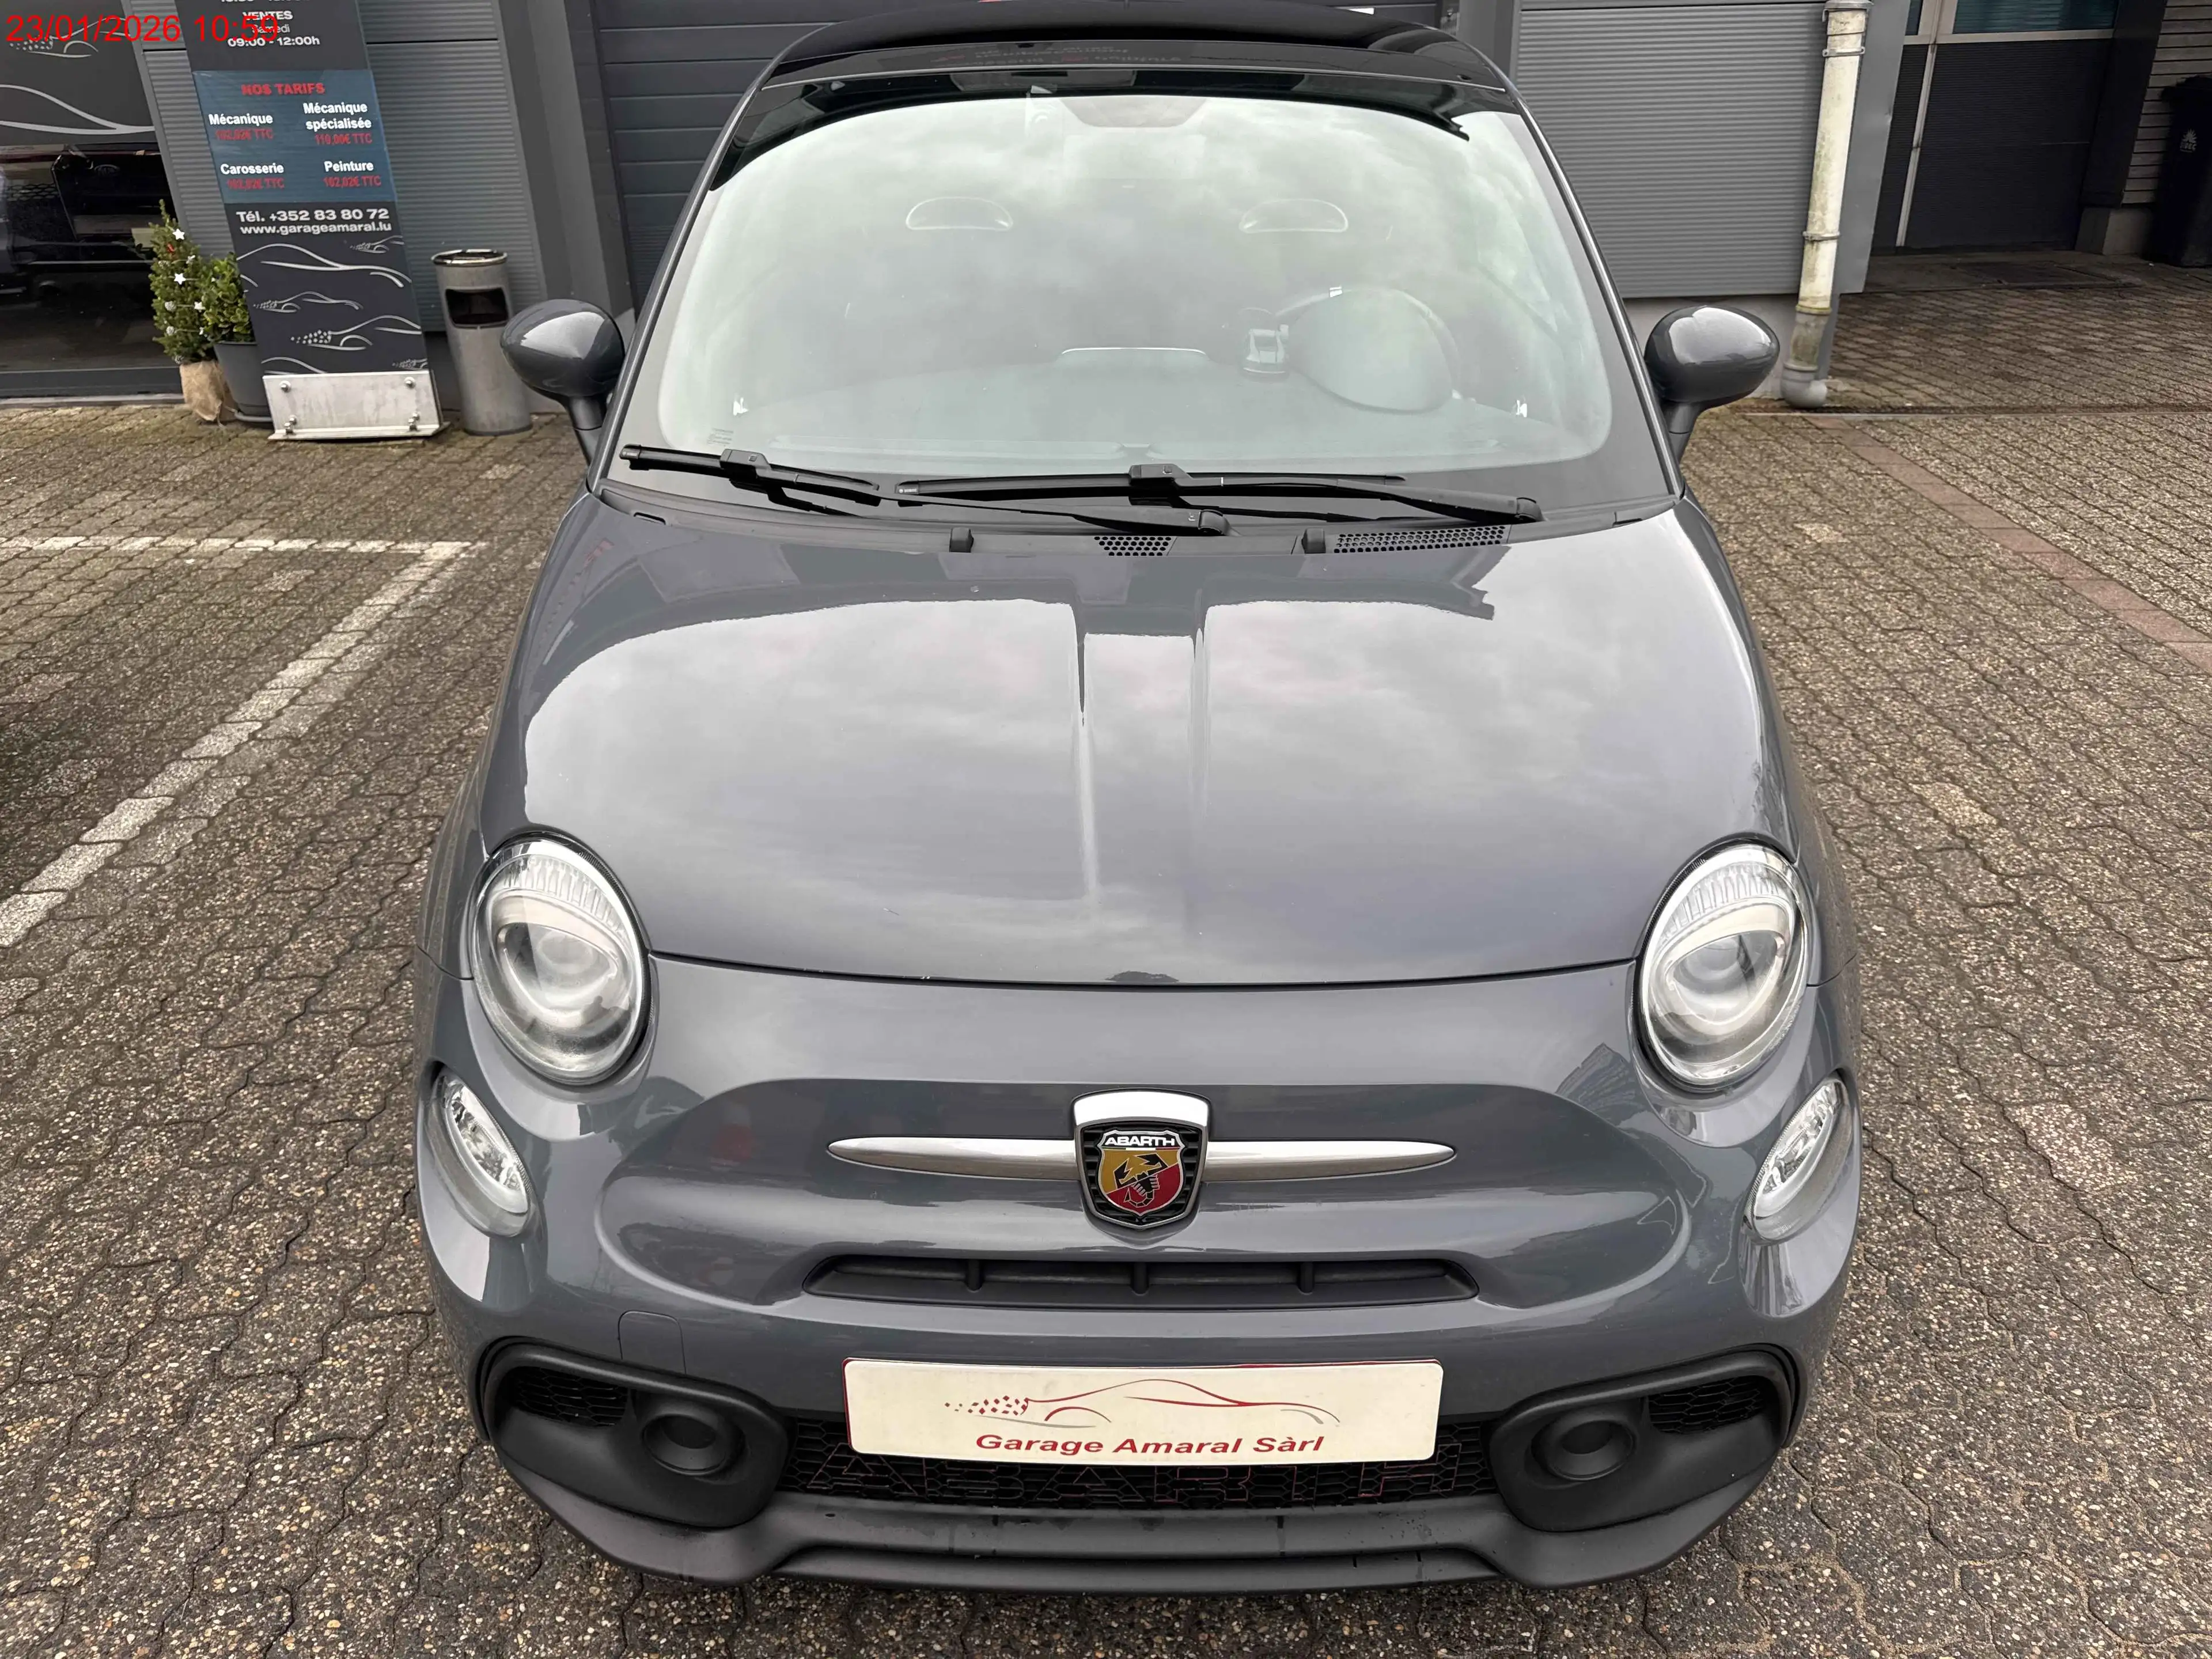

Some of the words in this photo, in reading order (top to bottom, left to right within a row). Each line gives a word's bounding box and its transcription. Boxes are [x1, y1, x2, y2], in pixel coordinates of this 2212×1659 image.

[242, 10, 293, 21] VENTES
[276, 36, 321, 46] 12:00h
[241, 84, 272, 96] NOS
[274, 82, 325, 94] TARIFS
[303, 101, 368, 115] Mécanique
[208, 113, 274, 127] Mécanique
[305, 117, 372, 132] spécialisée
[254, 128, 274, 141] TTC
[352, 132, 373, 144] TTC
[220, 162, 285, 175] Carosserie
[323, 160, 374, 172] Peinture
[264, 177, 285, 189] TTC
[361, 175, 382, 187] TTC
[236, 211, 265, 222] Tél.
[269, 210, 310, 221] +352
[313, 209, 337, 221] 83
[340, 209, 363, 220] 80
[366, 208, 390, 219] 72
[240, 221, 392, 236] www.garageamaral.lu
[1105, 1135, 1175, 1147] ABARTH
[975, 1434, 1104, 1456] Garage
[1112, 1438, 1243, 1454] Amaral
[1252, 1435, 1325, 1453] Sàrl
